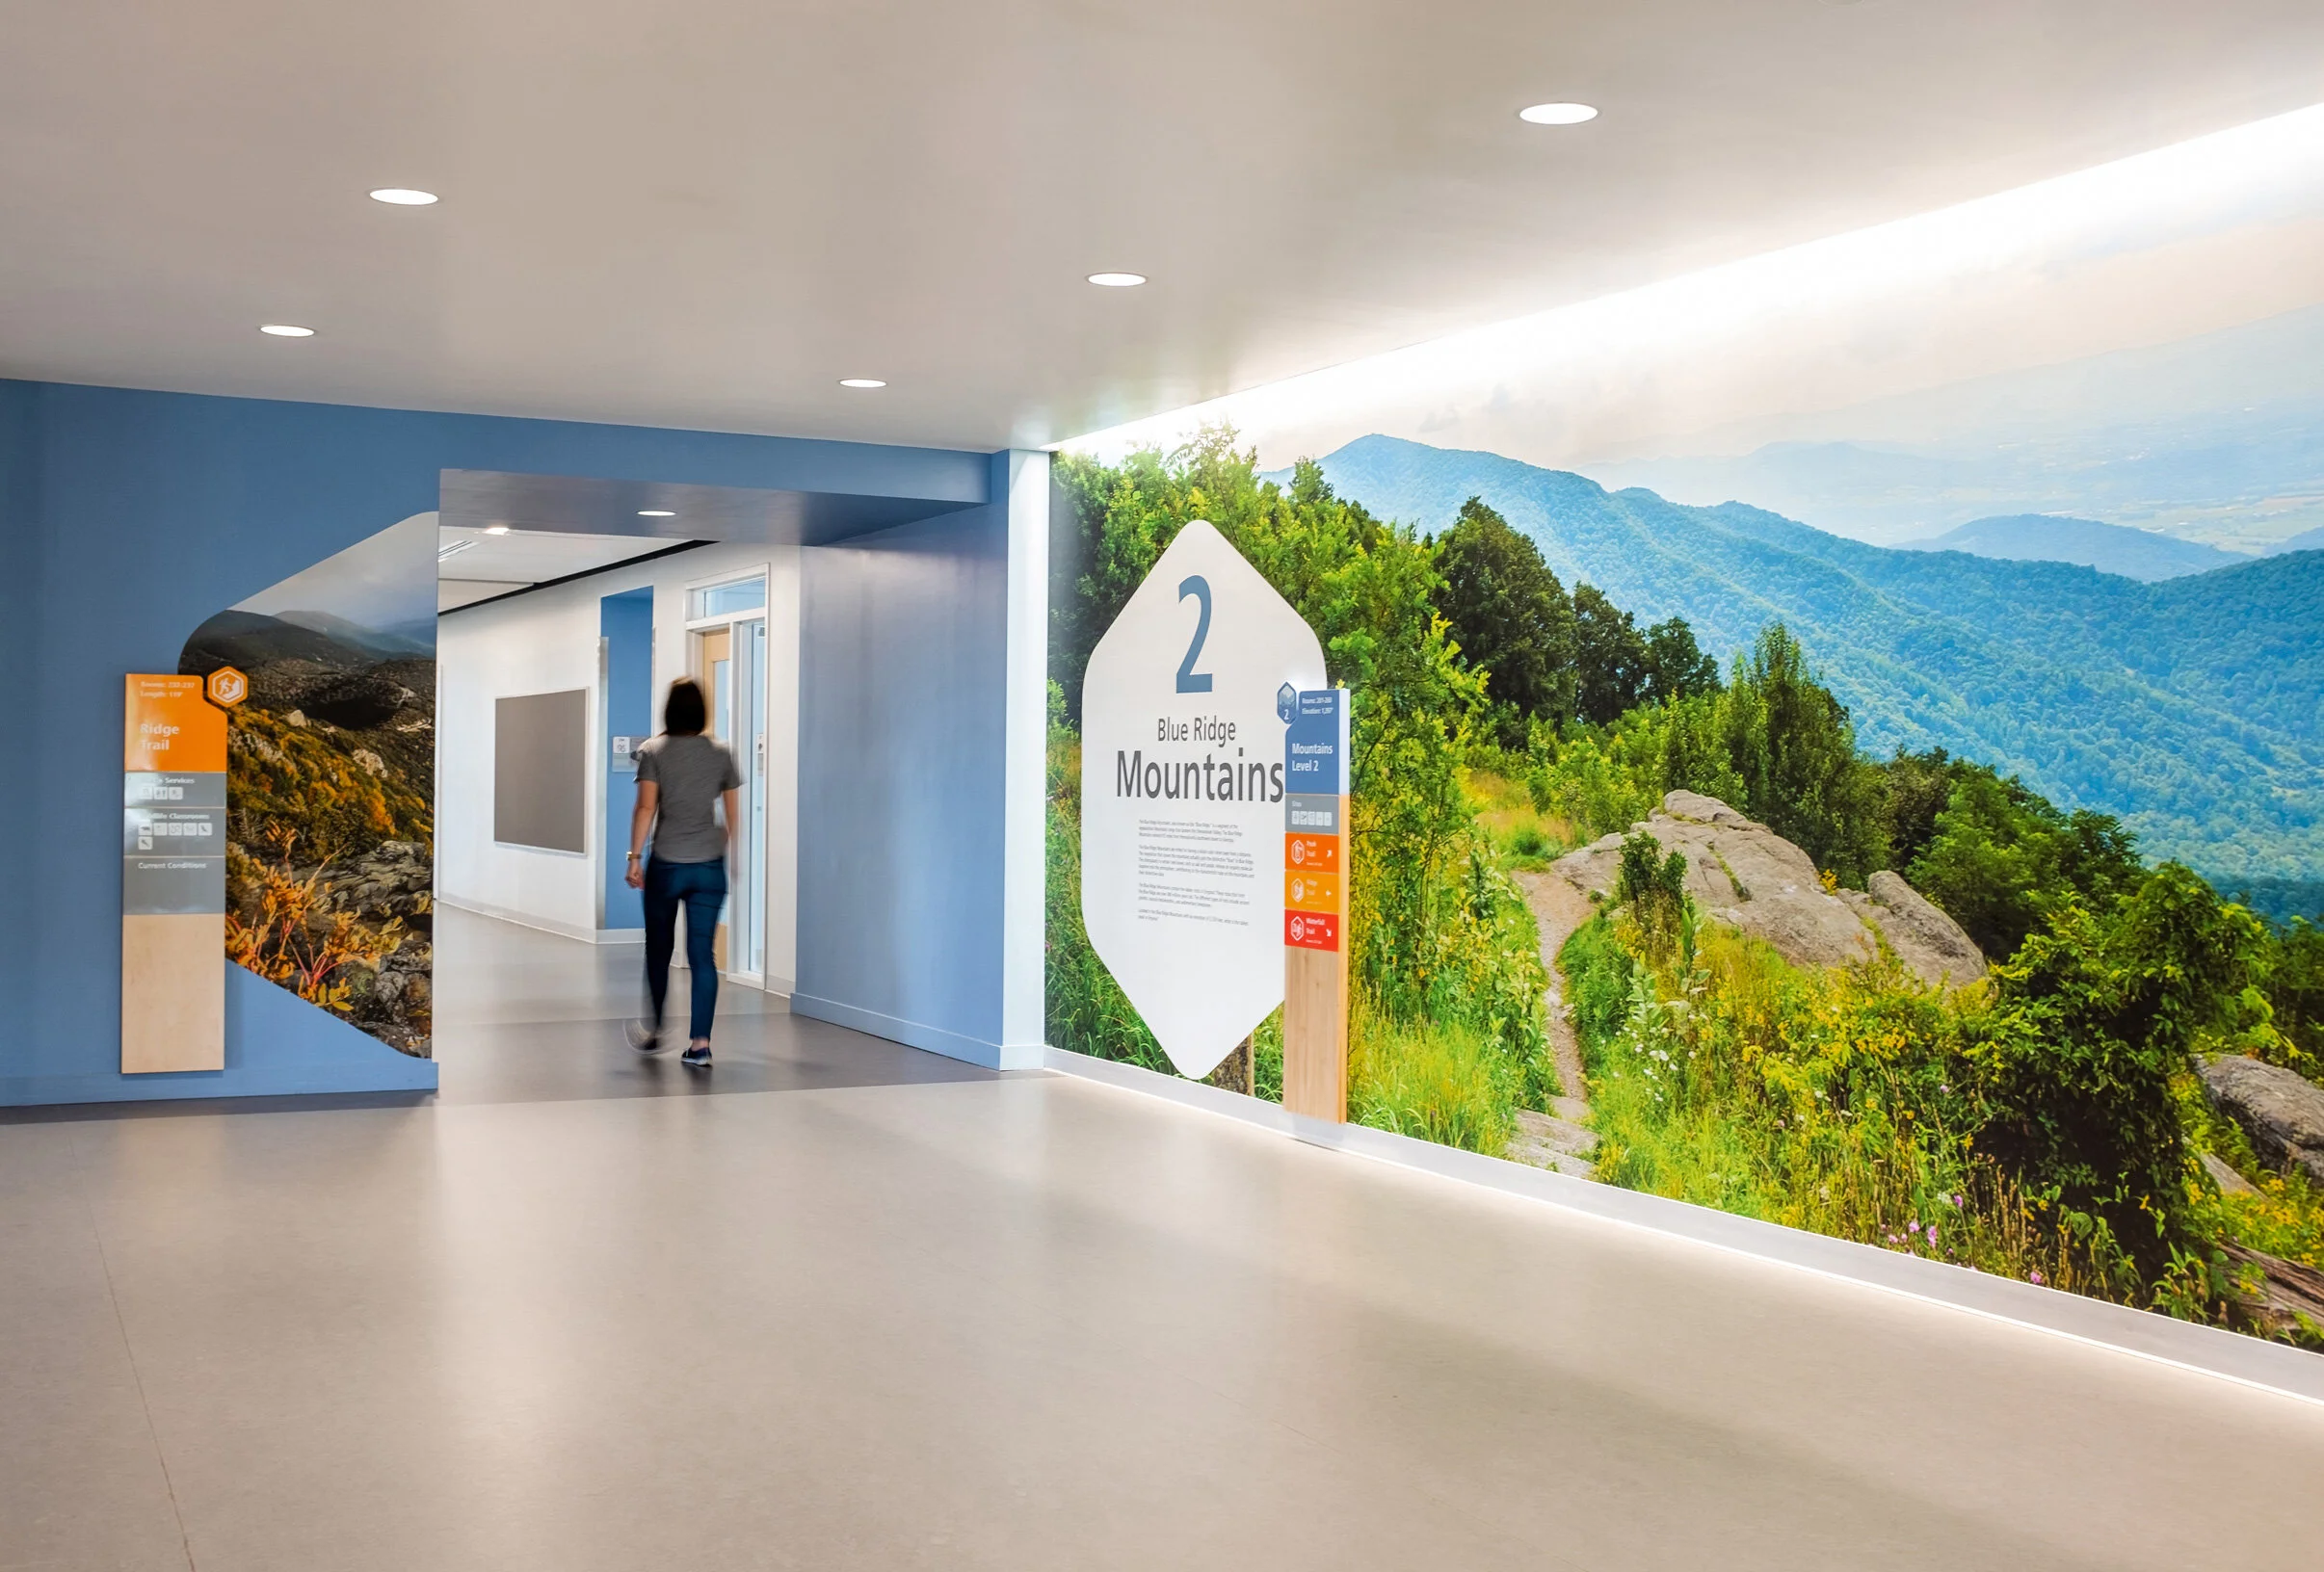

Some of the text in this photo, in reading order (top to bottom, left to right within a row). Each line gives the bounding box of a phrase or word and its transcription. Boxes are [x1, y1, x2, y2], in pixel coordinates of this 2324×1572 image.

[1175, 574, 1213, 694] 2
[1282, 709, 1289, 720] 2
[140, 723, 180, 737] Ridge
[1157, 717, 1236, 747] Blue Ridge
[140, 739, 170, 750] Trail
[1291, 743, 1334, 755] Mountains
[1291, 760, 1319, 772] Level 2
[1117, 747, 1283, 802] Mountains
